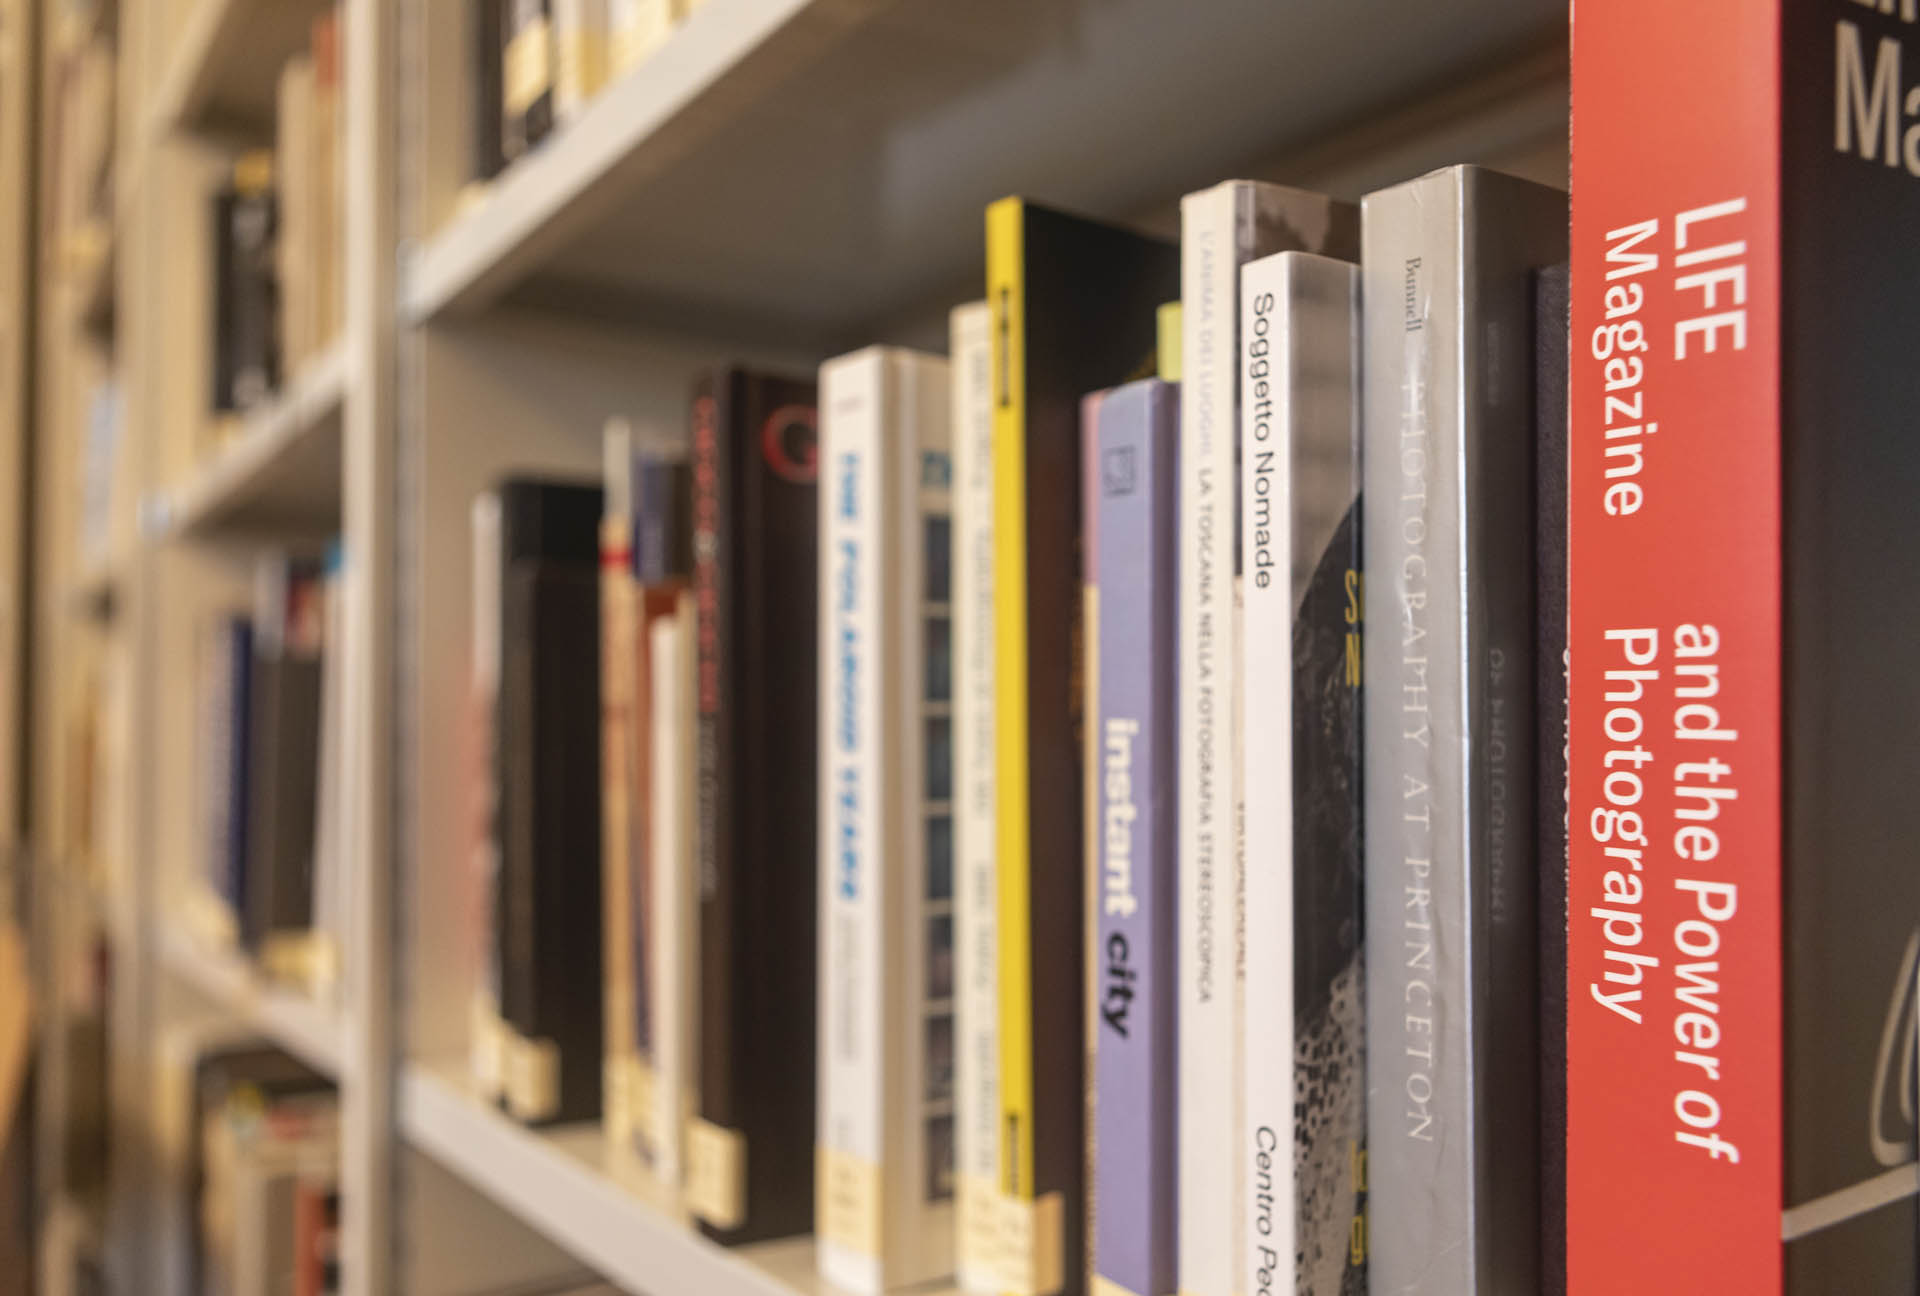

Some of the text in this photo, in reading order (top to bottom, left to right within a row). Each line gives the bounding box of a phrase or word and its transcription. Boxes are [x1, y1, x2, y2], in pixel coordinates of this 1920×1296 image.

[1405, 256, 1422, 333] Bunnell
[1591, 218, 1659, 516] Magazine
[1674, 197, 1746, 360] LIFE
[1250, 292, 1275, 590] Soggetto Nomade
[1101, 719, 1138, 1038] instant city
[1401, 382, 1434, 1143] PHOTOGRAPHY AT PRINCETON
[1590, 627, 1659, 1024] Photography
[1674, 623, 1739, 1163] and the Power of
[1256, 1126, 1277, 1236] Centro
